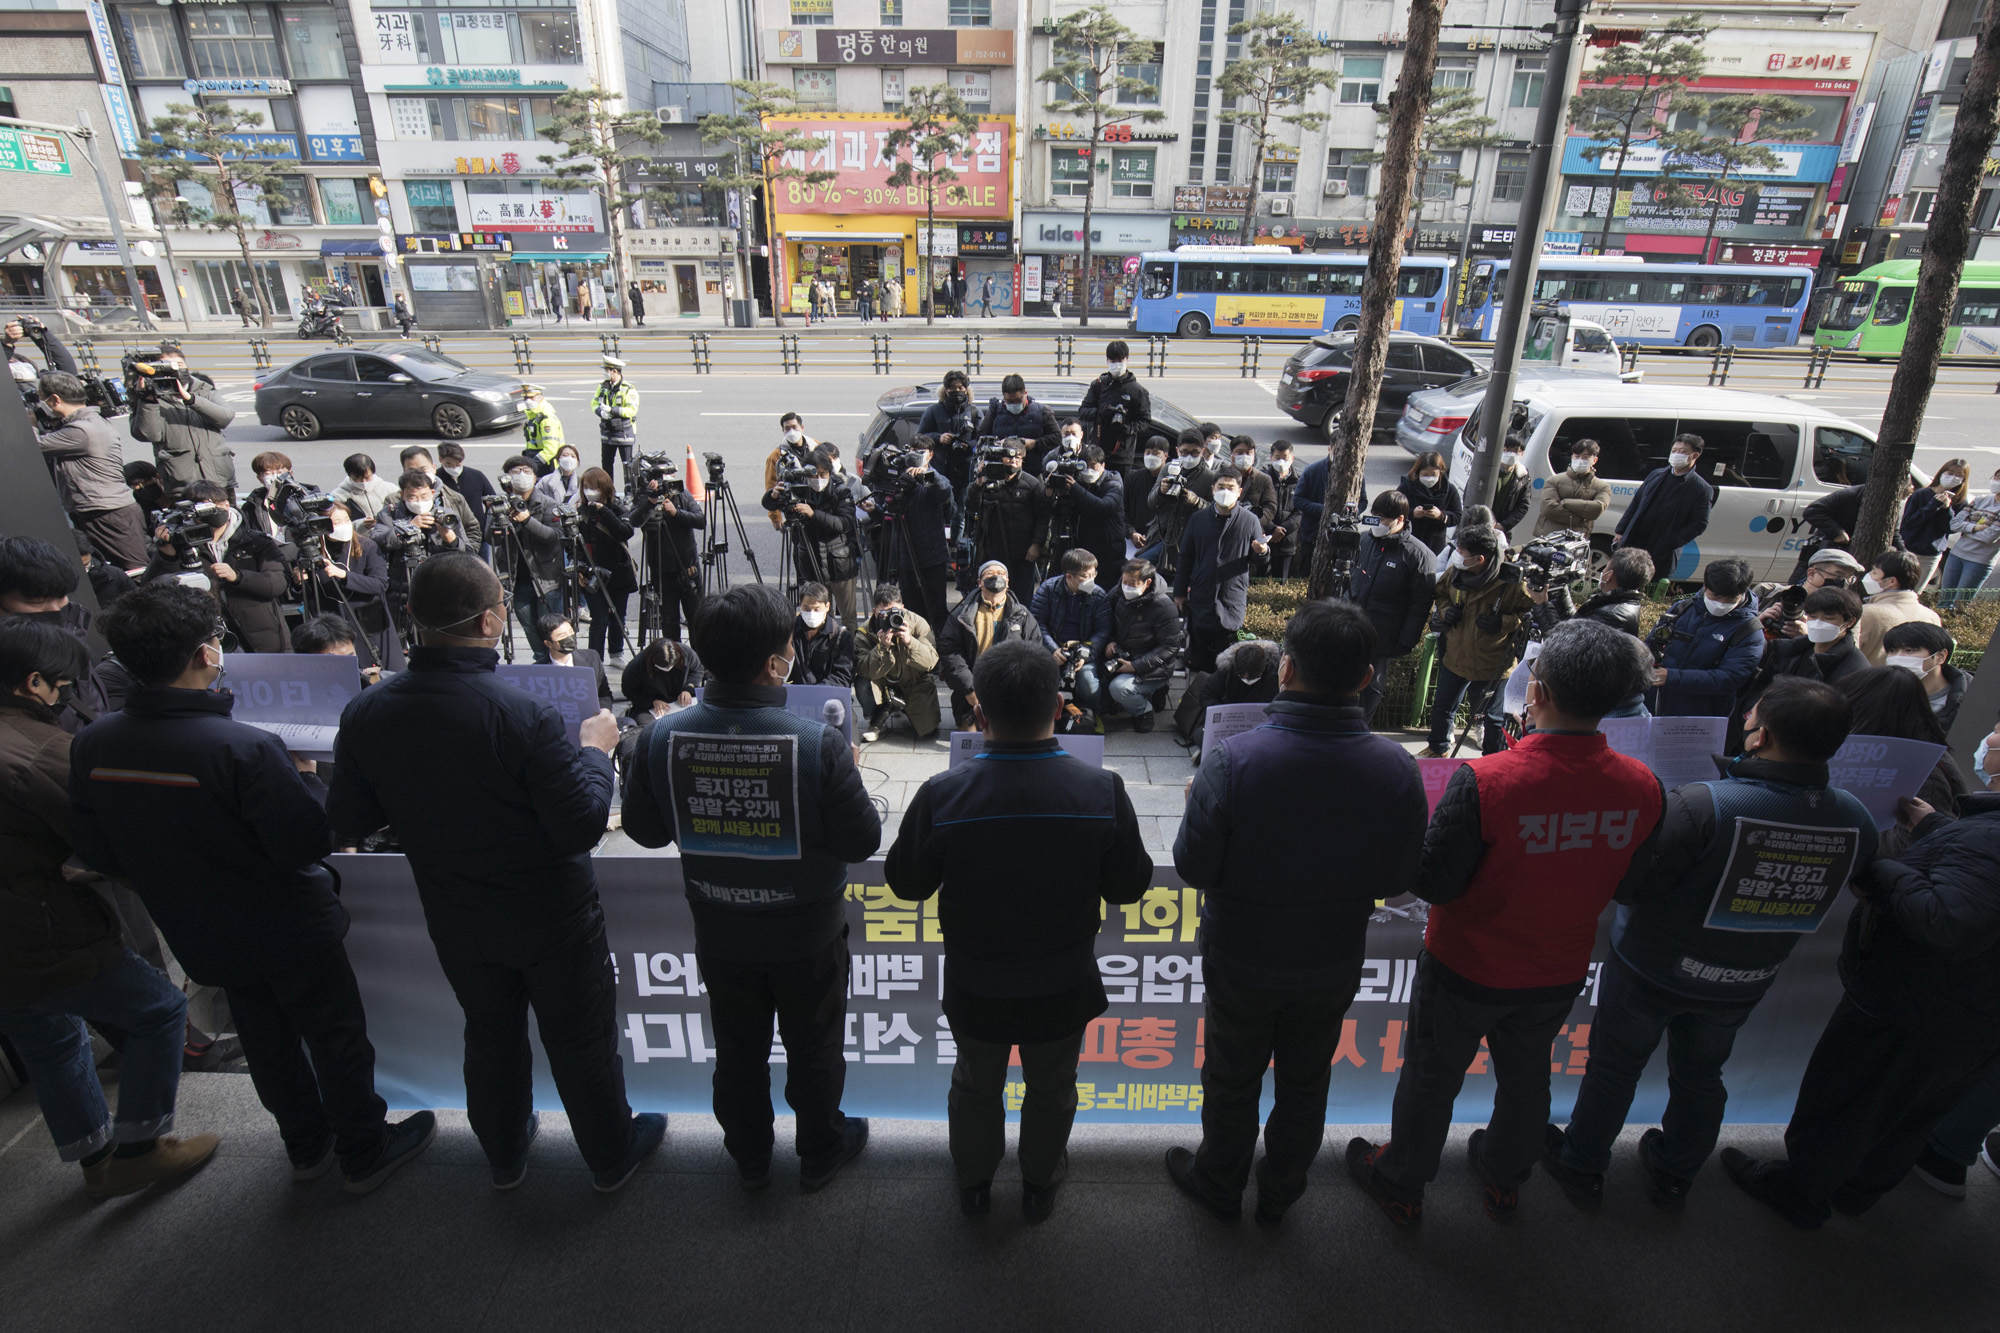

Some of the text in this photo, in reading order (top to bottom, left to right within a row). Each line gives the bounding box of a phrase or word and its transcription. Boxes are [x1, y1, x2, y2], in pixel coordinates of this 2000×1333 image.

[375, 15, 409, 31] 치과
[456, 15, 505, 29] 교정전문
[1787, 54, 1852, 71] 고이비토
[1104, 124, 1132, 142] 공증
[311, 137, 365, 158] 인후과
[695, 163, 719, 177] 헤어
[1058, 158, 1088, 172] 치과
[1119, 158, 1148, 172] 치과
[408, 185, 441, 202] 치과
[788, 180, 842, 205] 80%
[863, 188, 900, 205] 30%
[906, 185, 940, 206] BIG
[946, 185, 996, 207] SALE
[1316, 226, 1336, 239] 명동
[1482, 229, 1516, 243] 월드타
[553, 235, 569, 250] kt
[1752, 249, 1789, 264] 정관장
[1843, 281, 1865, 292] 7021
[1701, 309, 1720, 319] 103
[1612, 483, 1640, 497] ience
[1364, 517, 1379, 525] CBS
[1386, 561, 1397, 569] CBS
[695, 777, 769, 798] 죽지 않고
[687, 796, 781, 819] 일할 수 있게
[692, 817, 722, 835] 함께
[1518, 808, 1639, 854] 진보당
[1754, 861, 1827, 884] 죽지 않고
[1736, 877, 1828, 901] 일할 수 있게
[1730, 898, 1761, 914] 함께
